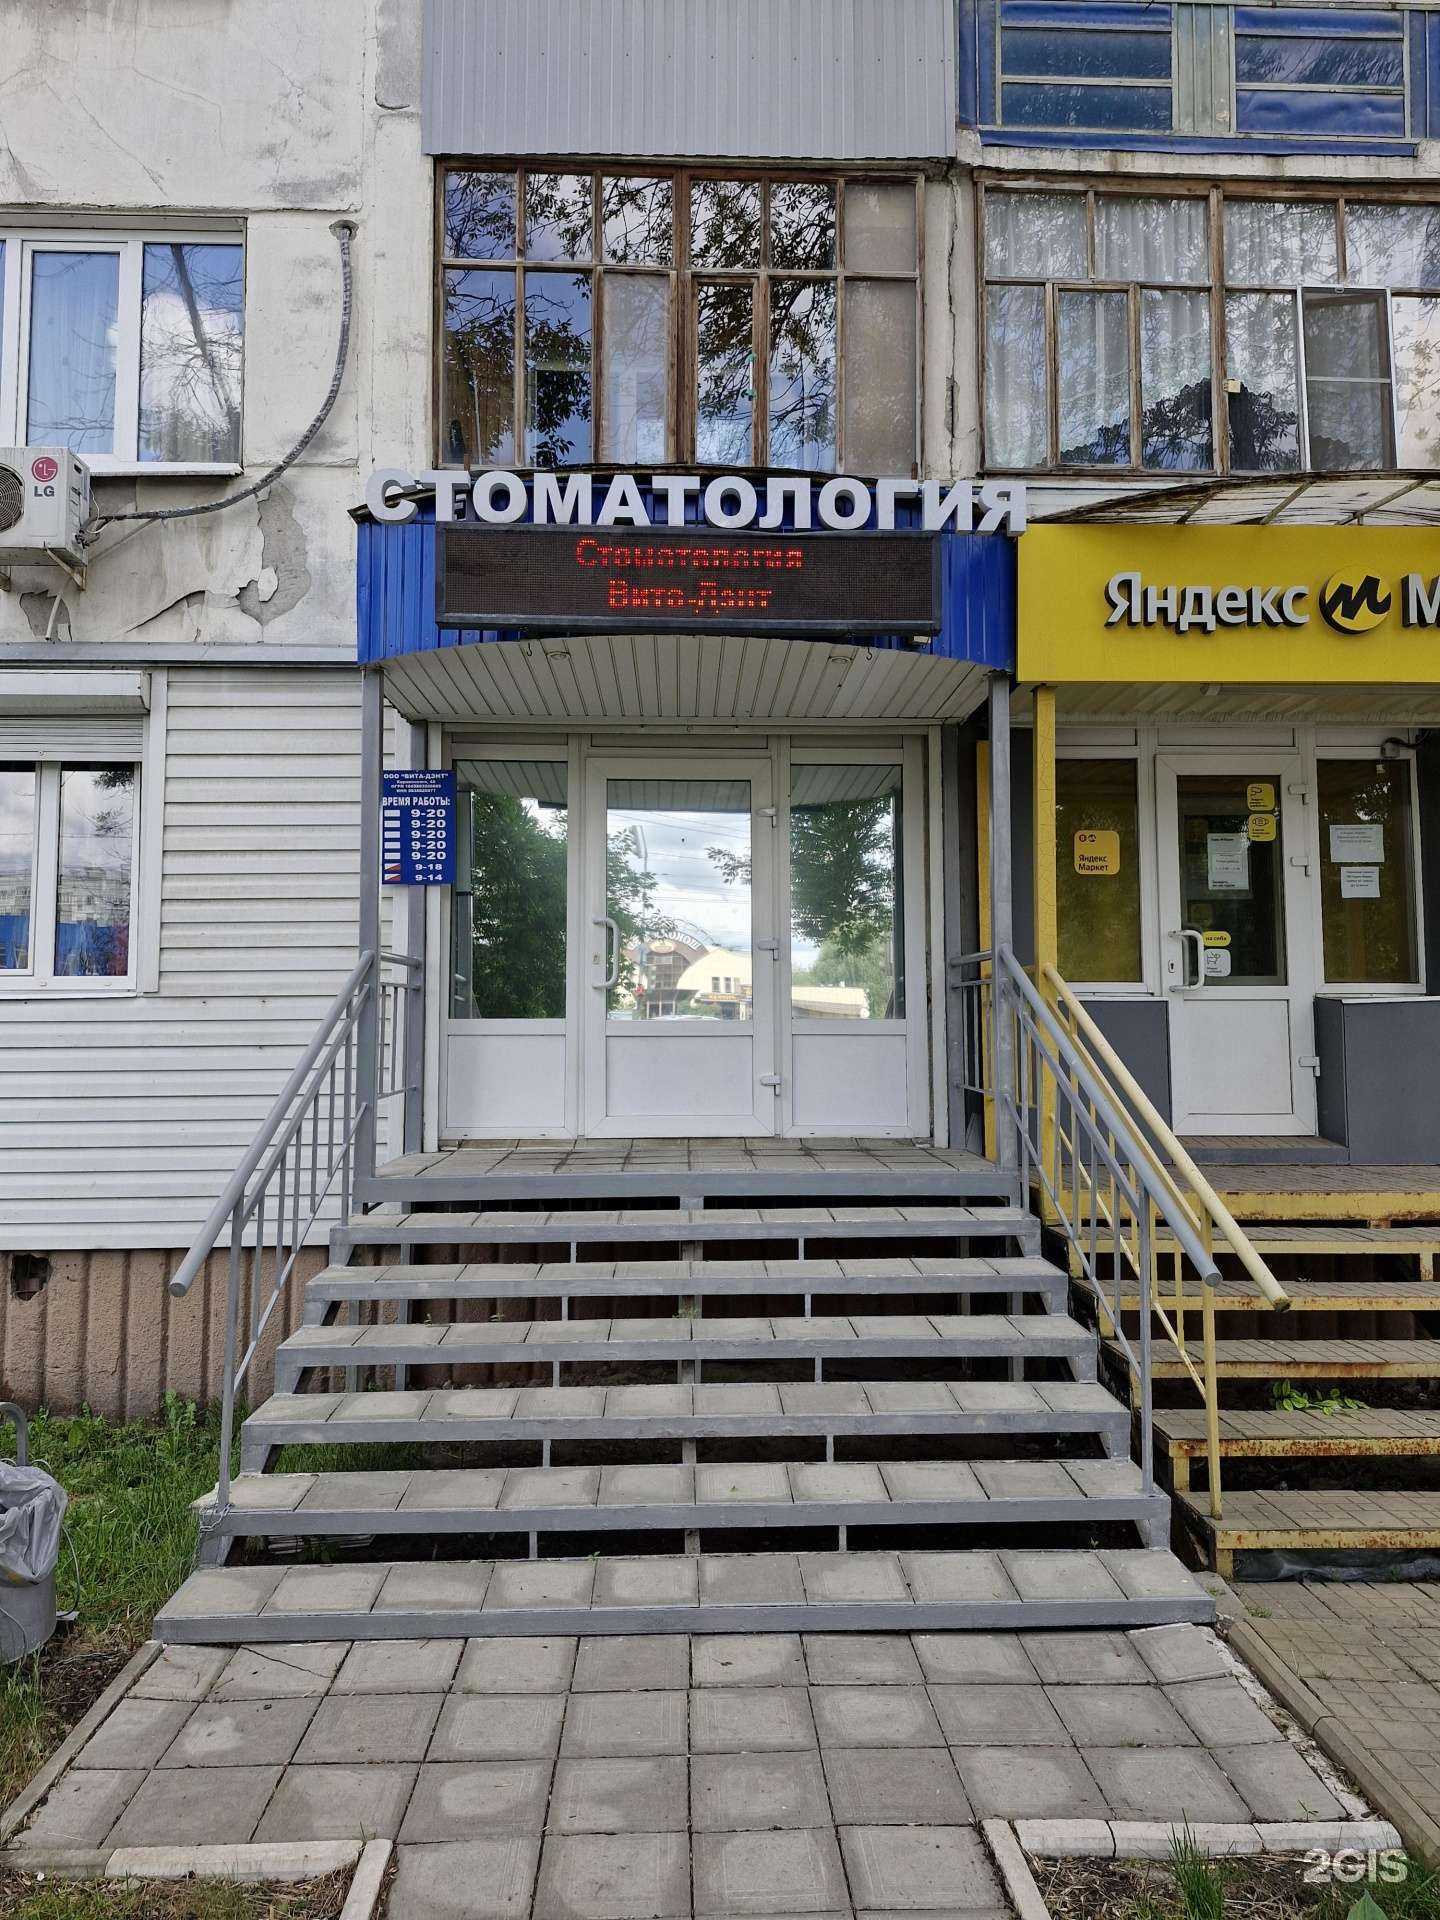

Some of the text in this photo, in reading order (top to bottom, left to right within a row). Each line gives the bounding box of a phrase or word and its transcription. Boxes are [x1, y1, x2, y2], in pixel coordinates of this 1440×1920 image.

[34, 486, 55, 498] LG
[366, 470, 1028, 537] СТОМАТОЛОГИЯ
[1104, 571, 1311, 634] Яндекс
[382, 796, 451, 806] ВРЕМЯ РАБОТЫ:
[411, 809, 446, 817] 9-20
[411, 819, 446, 828] 9-20
[411, 830, 446, 839] 9-20
[411, 841, 446, 850] 9-20
[411, 851, 446, 860] 9-20
[1078, 855, 1108, 863] Яндекс
[415, 863, 443, 871] 9-18
[1078, 863, 1109, 872] Маркет
